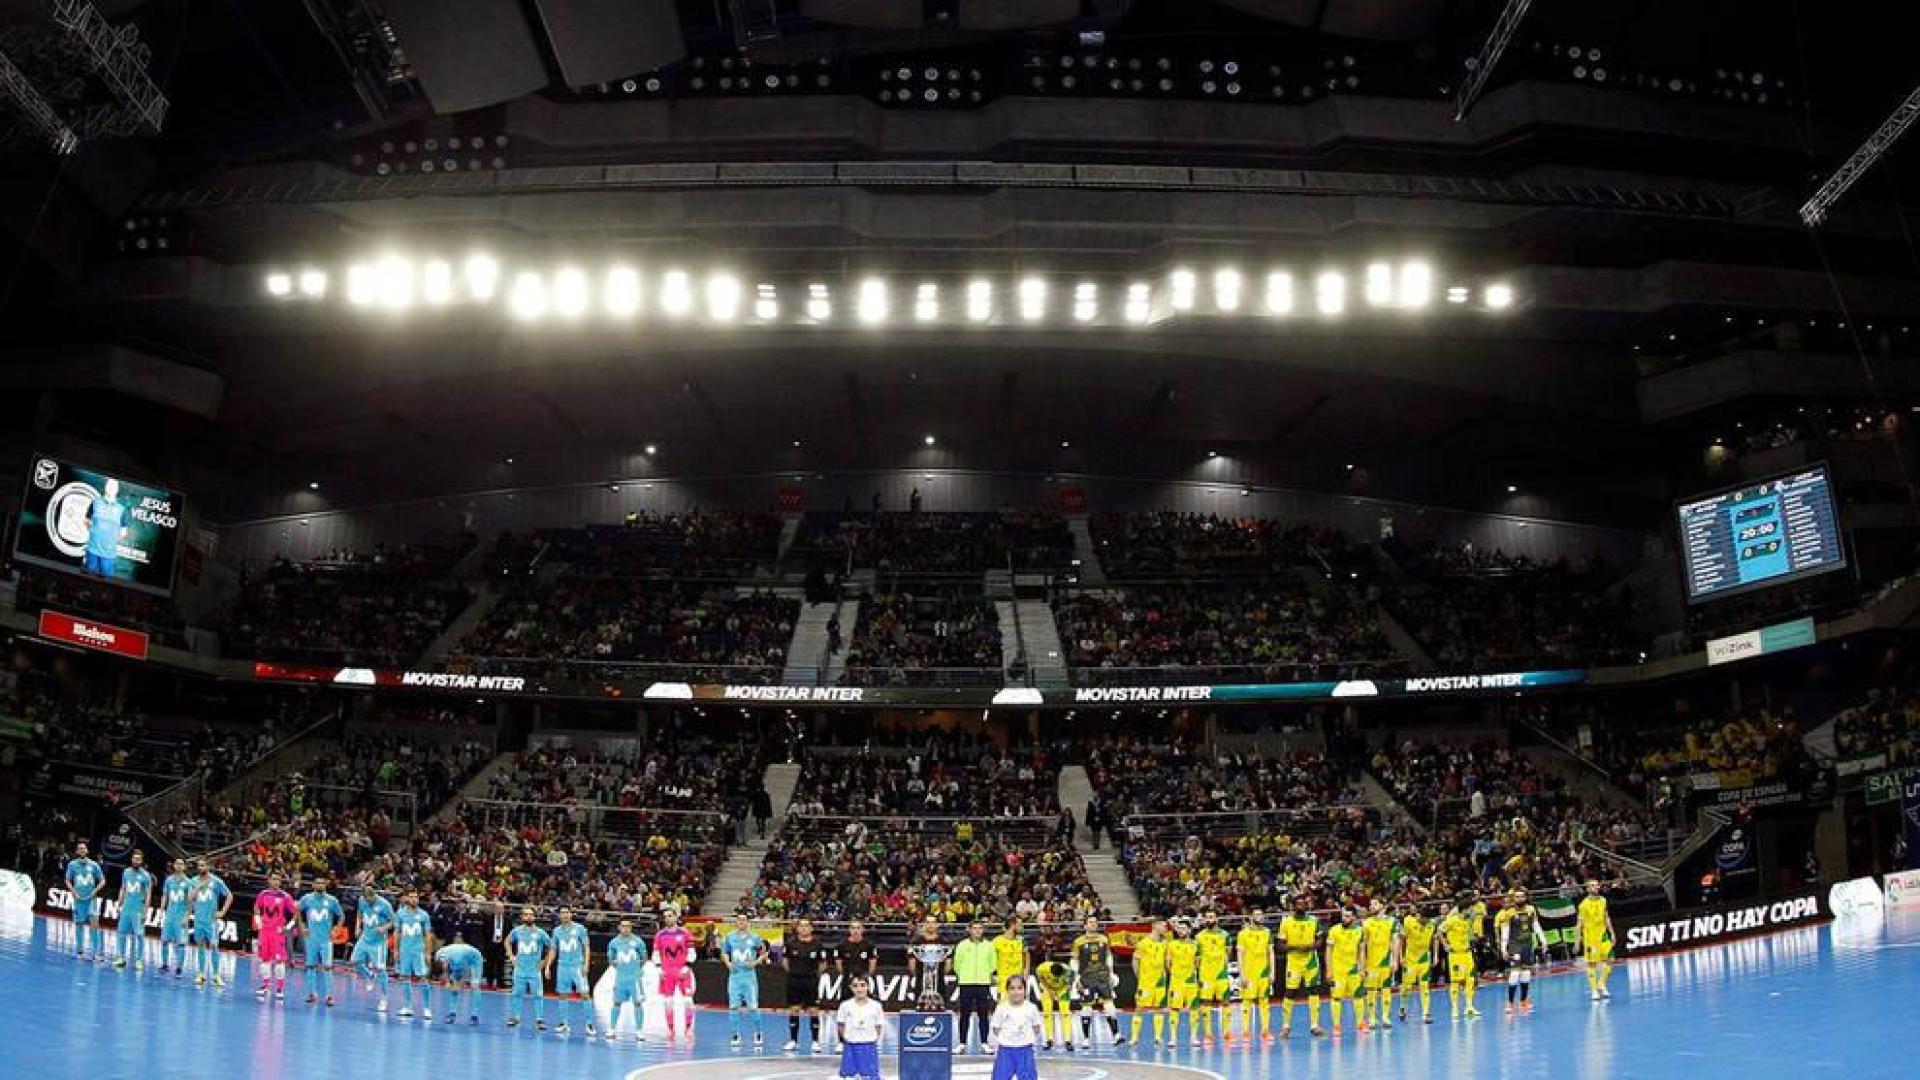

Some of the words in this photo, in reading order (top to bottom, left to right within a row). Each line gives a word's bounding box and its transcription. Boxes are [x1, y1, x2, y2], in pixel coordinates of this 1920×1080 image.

[131, 507, 177, 528] VELASCO
[402, 671, 478, 688] MOVISTAR
[479, 676, 525, 691] INTER
[1405, 675, 1479, 691] MOVISTAR
[1481, 673, 1521, 688] INTER
[725, 685, 809, 700] MOVISTAR
[812, 687, 863, 701] INTER
[1075, 687, 1160, 701] MOVISTAR
[1163, 685, 1211, 699] INTER
[1626, 922, 1666, 949] SIN
[1669, 919, 1691, 941] TI
[1693, 913, 1723, 938] NO
[1725, 904, 1768, 932] HAY
[1770, 896, 1818, 923] COPA
